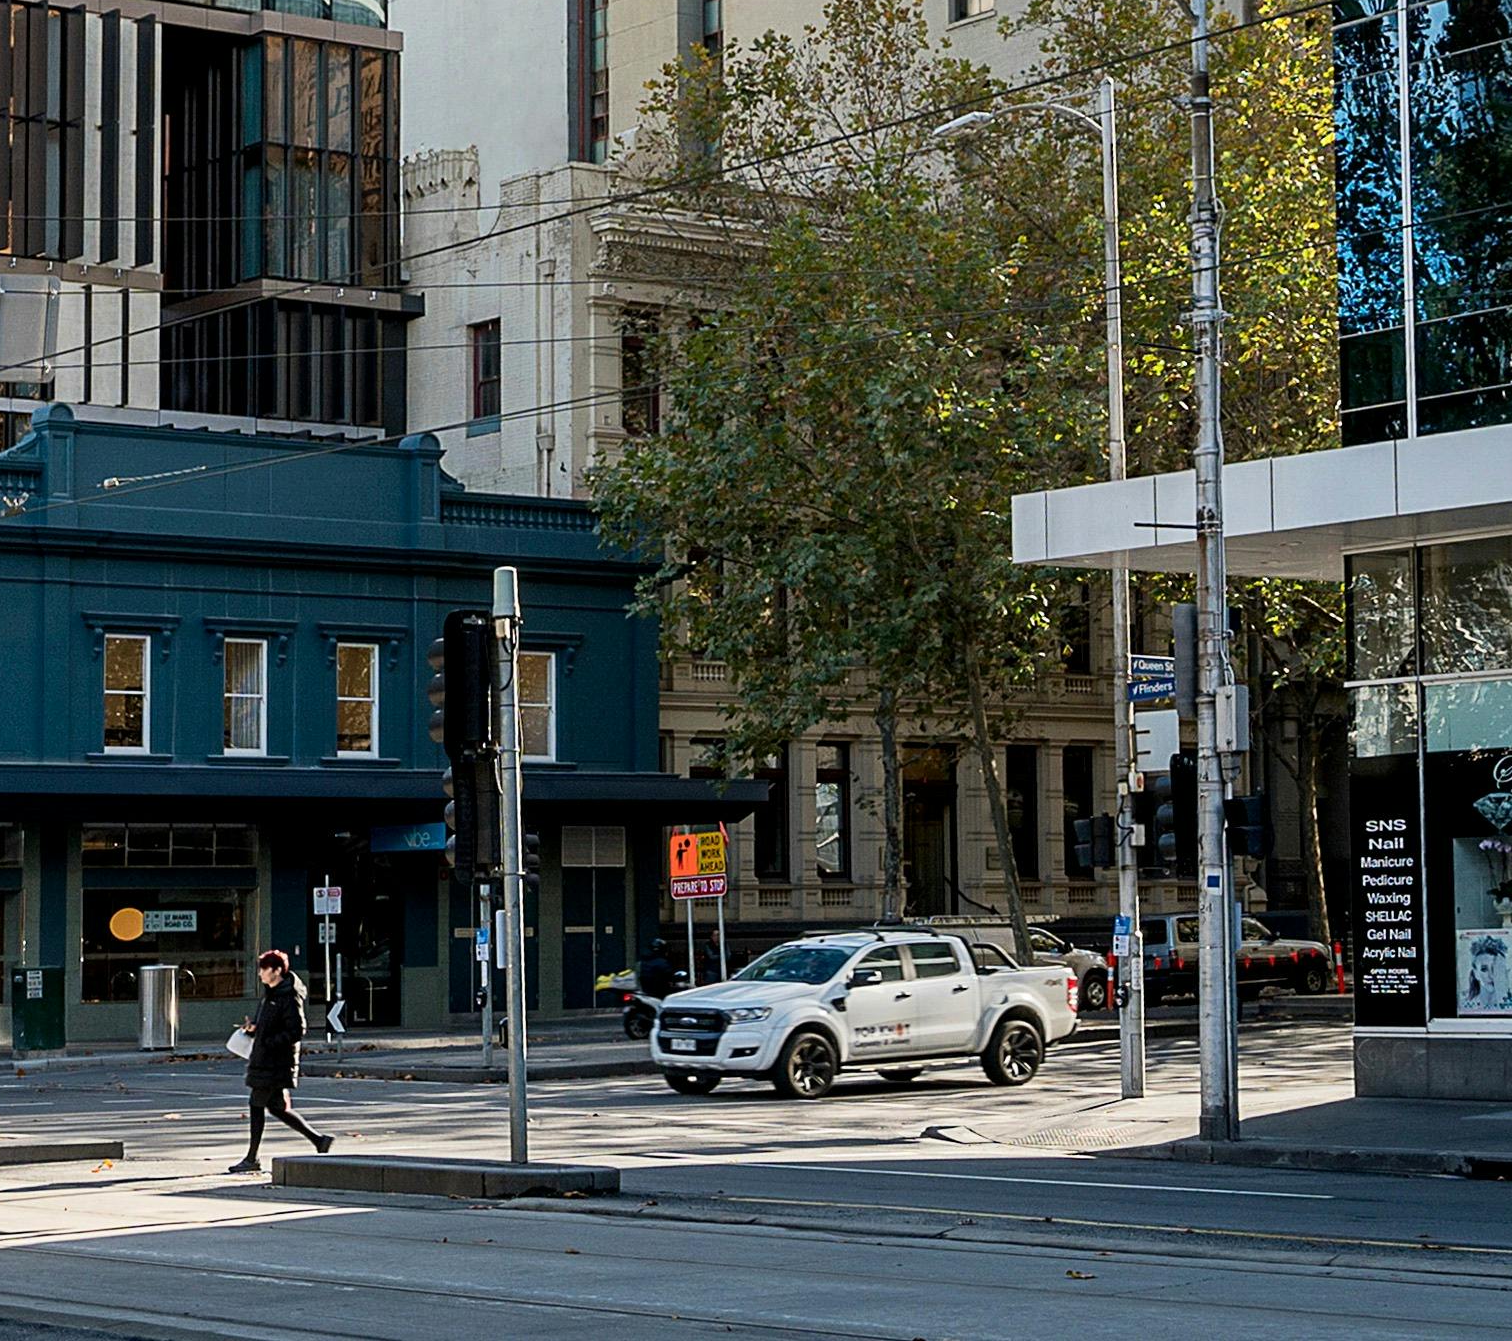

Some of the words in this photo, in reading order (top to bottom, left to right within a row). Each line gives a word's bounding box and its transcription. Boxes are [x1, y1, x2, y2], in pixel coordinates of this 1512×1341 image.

[1138, 659, 1164, 671] Queen
[1138, 682, 1173, 695] Flinders
[1365, 819, 1407, 832] SNS
[1368, 837, 1404, 850] Nail
[1360, 856, 1414, 868] Manicure
[1362, 874, 1414, 886] Pedicure
[1367, 892, 1411, 906] Waxing
[1365, 909, 1413, 922] SHELLAC
[1367, 929, 1387, 940] Gel
[1389, 928, 1412, 940] Nail
[1362, 946, 1396, 961] Acrylic
[1397, 946, 1417, 958] Nail
